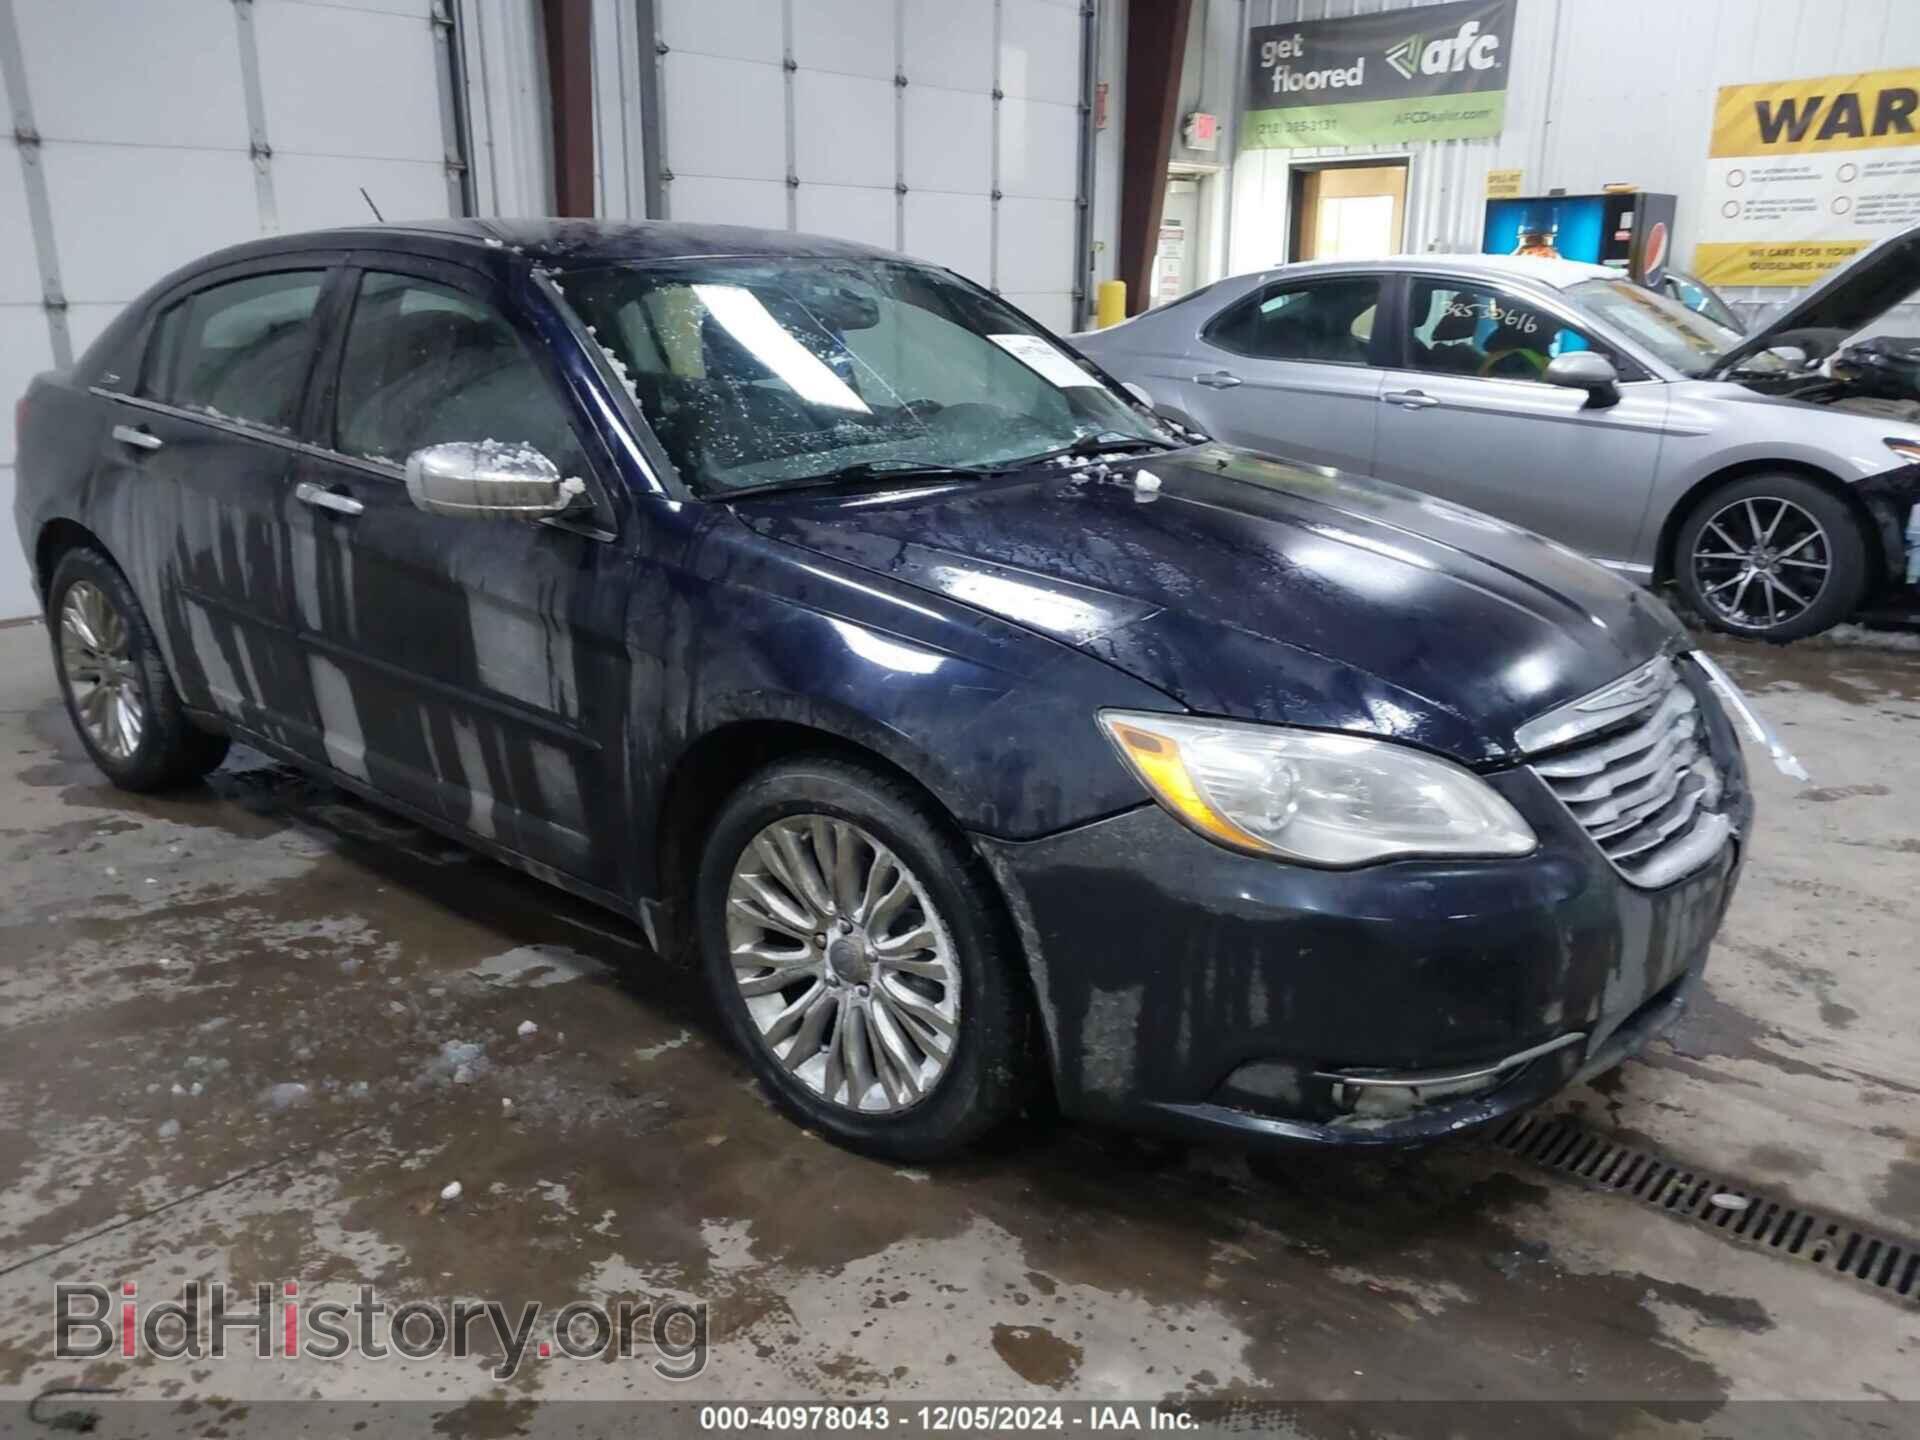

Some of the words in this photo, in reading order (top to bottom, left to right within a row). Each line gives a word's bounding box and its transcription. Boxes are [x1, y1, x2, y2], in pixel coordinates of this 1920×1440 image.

[1261, 33, 1303, 68] get
[1421, 20, 1499, 75] afc
[1272, 57, 1365, 93] floored
[1754, 88, 1918, 144] WAR
[1768, 247, 1796, 257] CARE
[1799, 247, 1820, 257] FOR
[1826, 247, 1857, 257] YOUR
